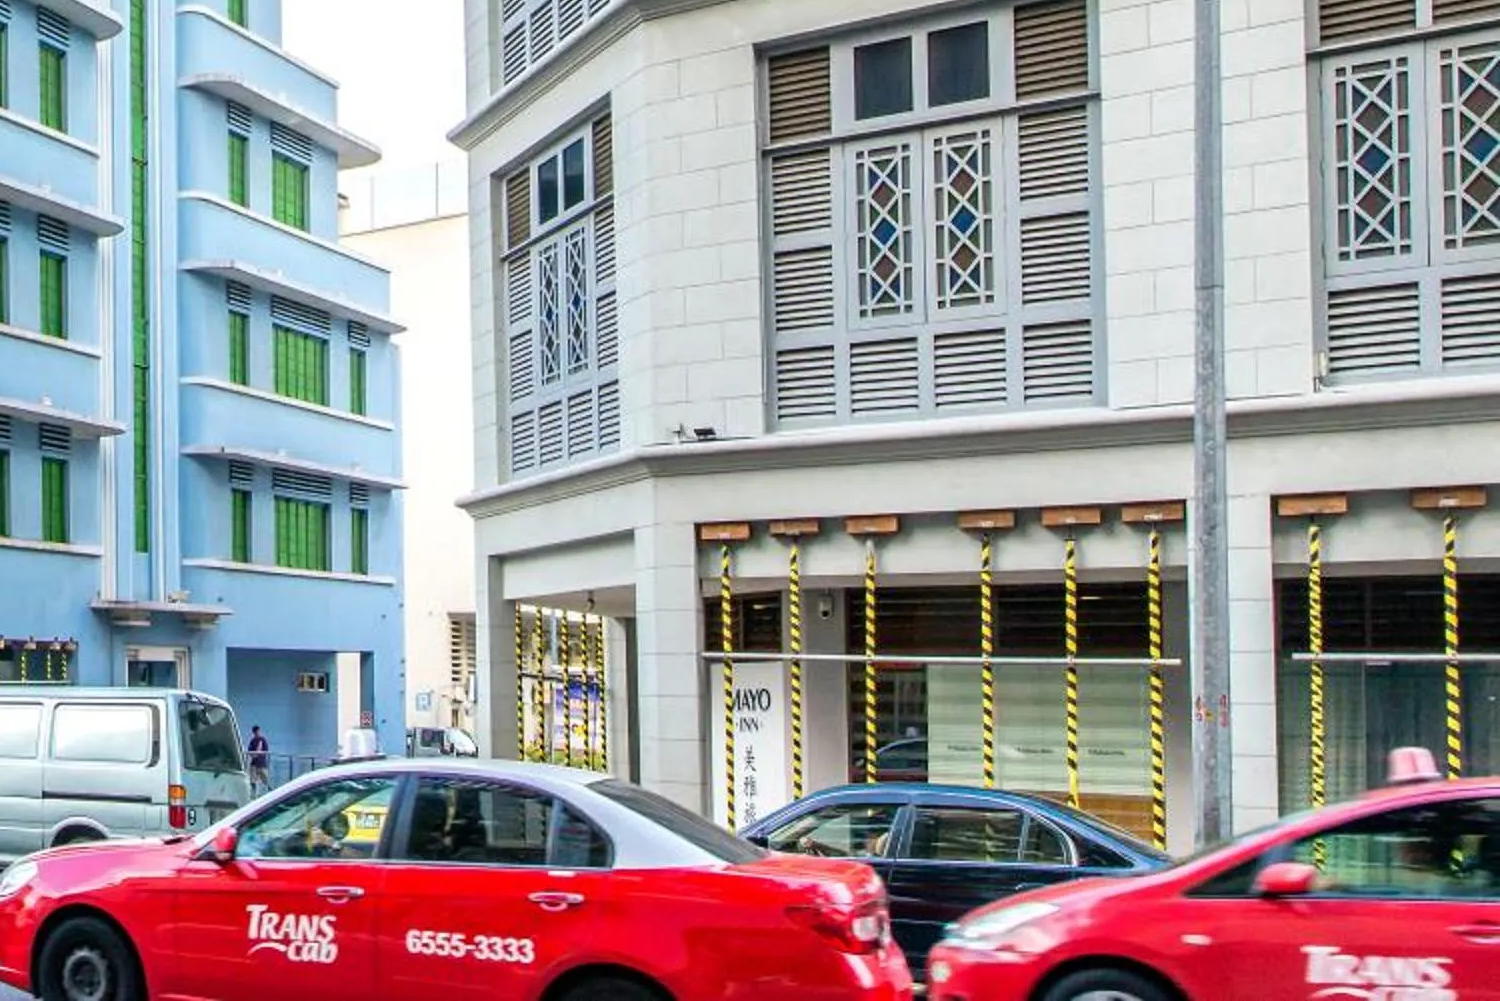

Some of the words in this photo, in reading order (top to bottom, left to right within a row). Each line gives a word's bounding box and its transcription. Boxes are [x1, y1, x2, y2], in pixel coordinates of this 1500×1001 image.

[732, 687, 771, 712] MAYO
[245, 903, 337, 943] TRANS
[286, 940, 339, 964] cab
[405, 928, 536, 964] 6555-3333
